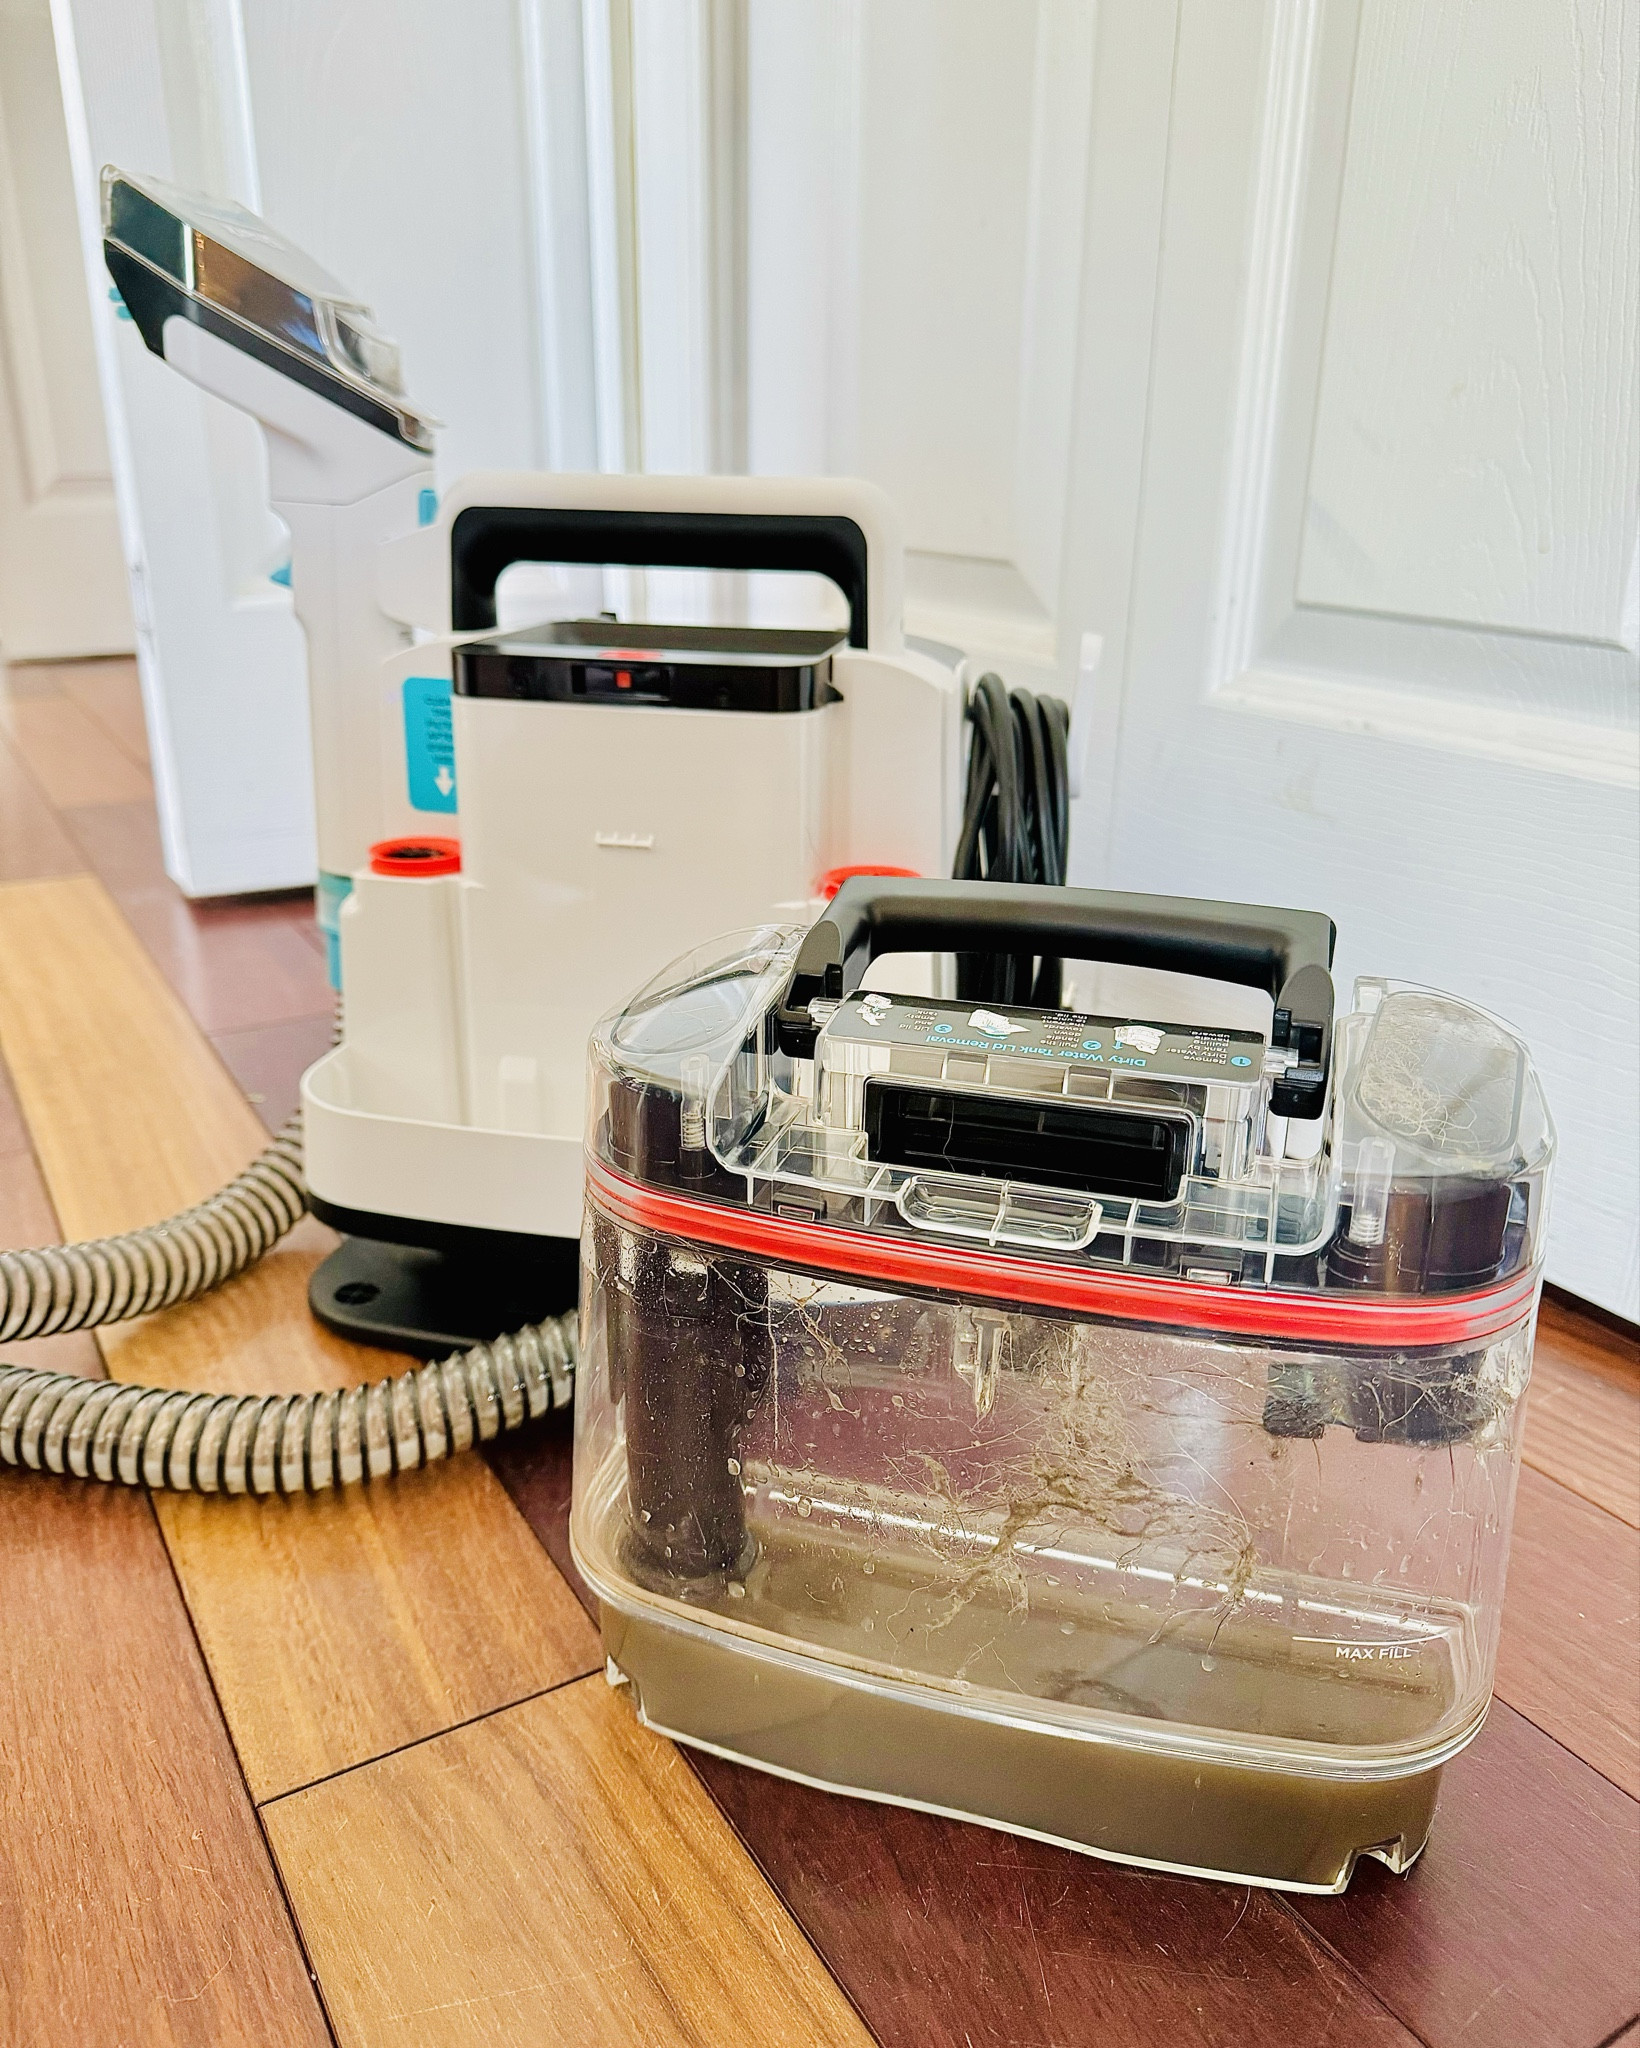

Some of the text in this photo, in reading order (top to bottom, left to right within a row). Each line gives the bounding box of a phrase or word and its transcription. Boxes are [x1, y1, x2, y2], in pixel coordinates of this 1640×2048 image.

[925, 1035, 1147, 1067] Dirty Water Tank Lid Removal
[1166, 1048, 1198, 1056] Water
[1184, 1056, 1226, 1064] Remove
[1335, 1646, 1412, 1660] MAX FILL
